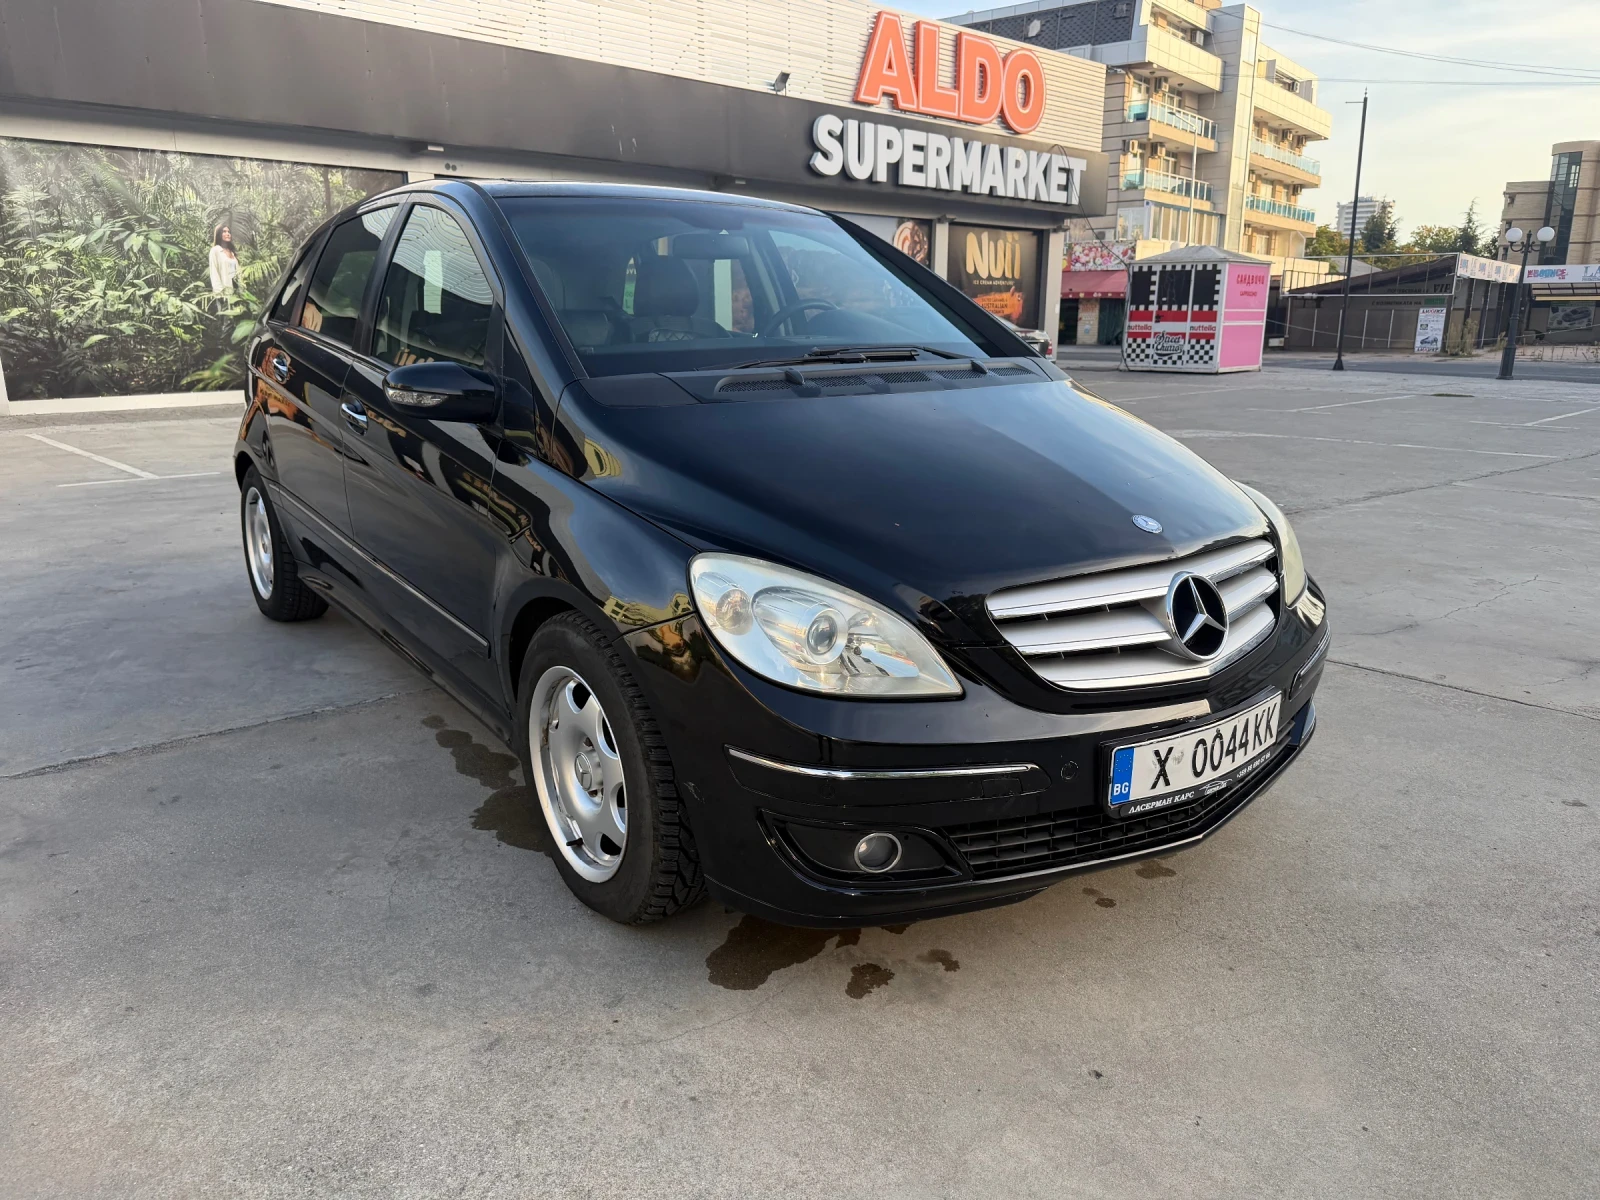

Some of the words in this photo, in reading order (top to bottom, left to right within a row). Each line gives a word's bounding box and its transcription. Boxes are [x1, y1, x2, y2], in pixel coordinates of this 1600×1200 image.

[853, 10, 1046, 134] ALDO
[809, 114, 1087, 205] SUPERMARKET
[966, 231, 1021, 279] Nuii
[1155, 330, 1181, 344] Street
[1113, 781, 1129, 796] BG
[1173, 790, 1195, 803] КАРС
